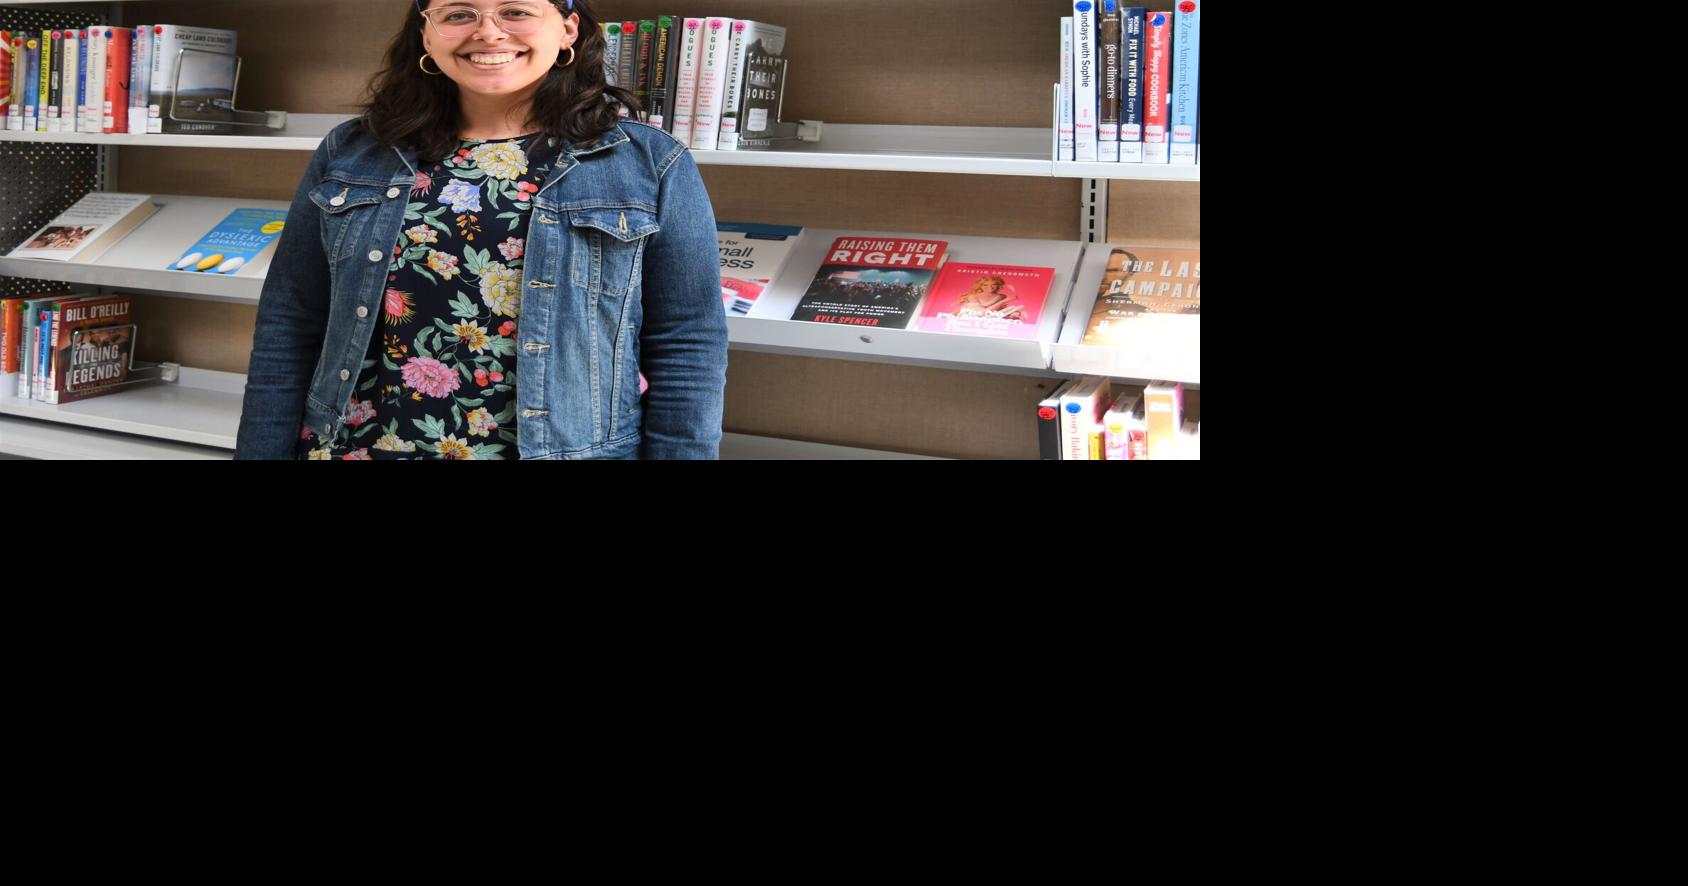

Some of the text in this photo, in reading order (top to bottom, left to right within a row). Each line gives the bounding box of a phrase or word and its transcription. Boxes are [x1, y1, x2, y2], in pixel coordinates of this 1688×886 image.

[1081, 12, 1090, 40] undays
[659, 28, 667, 62] AMERICAN
[1081, 60, 1090, 87] Sophie
[1105, 44, 1117, 99] go-to dinners
[1180, 47, 1190, 82] American
[750, 70, 776, 83] THEIR
[1150, 74, 1159, 116] COOKBOOK
[1179, 84, 1190, 112] Kitchen
[209, 231, 272, 243] DYSLEXIC
[838, 239, 938, 253] RAISING THEM
[830, 250, 933, 266] RIGHT
[1122, 260, 1200, 278] THE LAS
[1110, 279, 1200, 298] CAMPAI
[66, 308, 87, 322] BILL
[90, 303, 129, 318] O'REILLY
[815, 314, 879, 326] KYLE SPENCER
